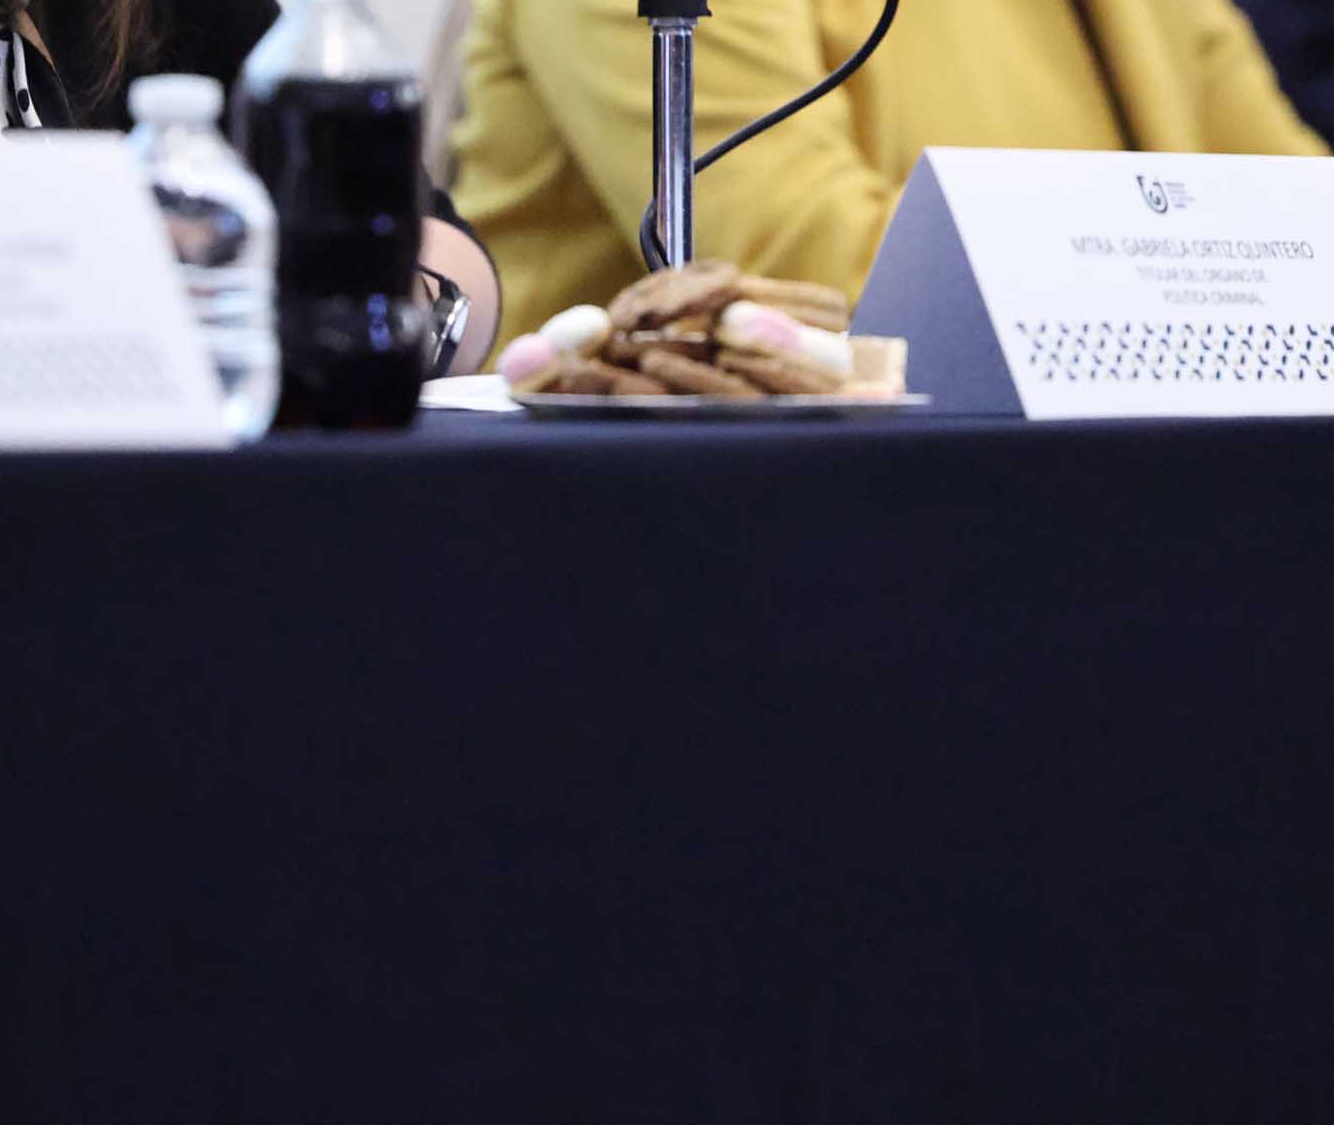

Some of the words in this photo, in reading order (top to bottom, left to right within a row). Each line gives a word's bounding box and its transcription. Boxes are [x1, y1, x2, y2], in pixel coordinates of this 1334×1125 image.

[1119, 236, 1190, 259] GABRIELA
[1192, 238, 1236, 259] ORTIZ
[1237, 239, 1314, 260] QUINTERO
